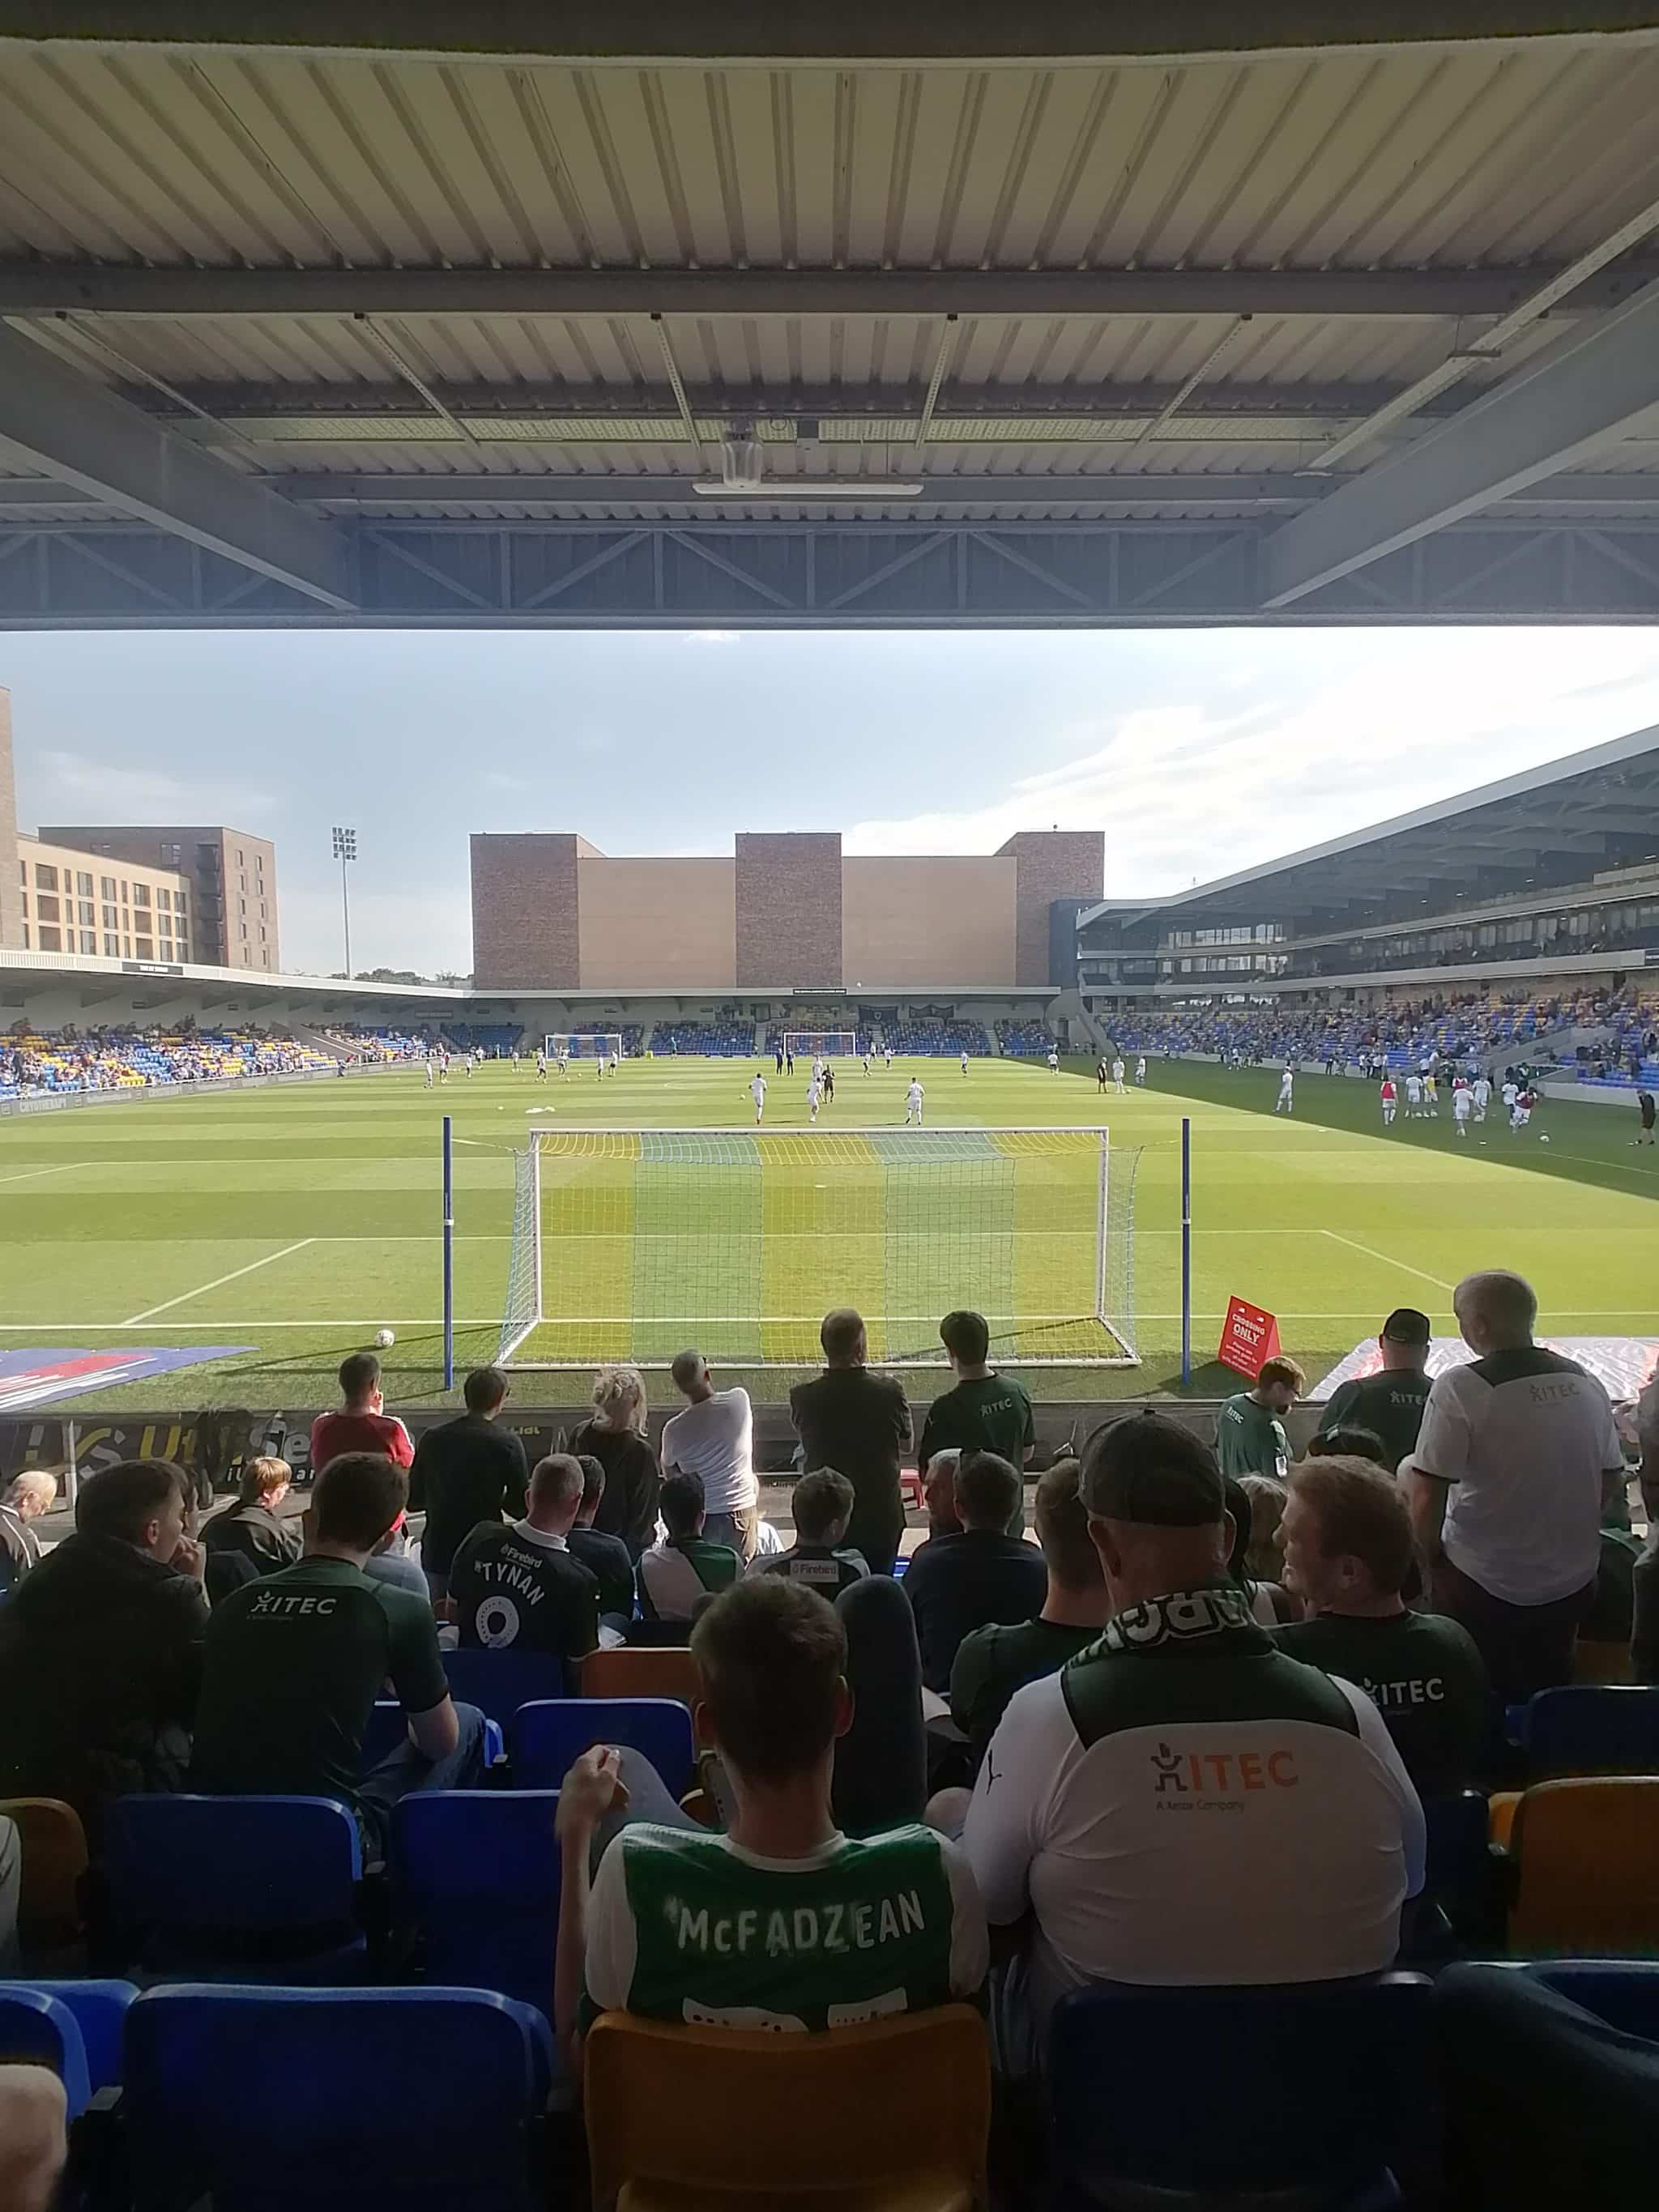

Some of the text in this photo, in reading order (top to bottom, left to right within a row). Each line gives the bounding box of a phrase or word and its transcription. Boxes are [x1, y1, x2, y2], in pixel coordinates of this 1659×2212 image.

[1234, 1323, 1260, 1343] ONLY
[481, 1562, 545, 1605] TYNAN
[678, 1890, 926, 1954] McFADZEAN
